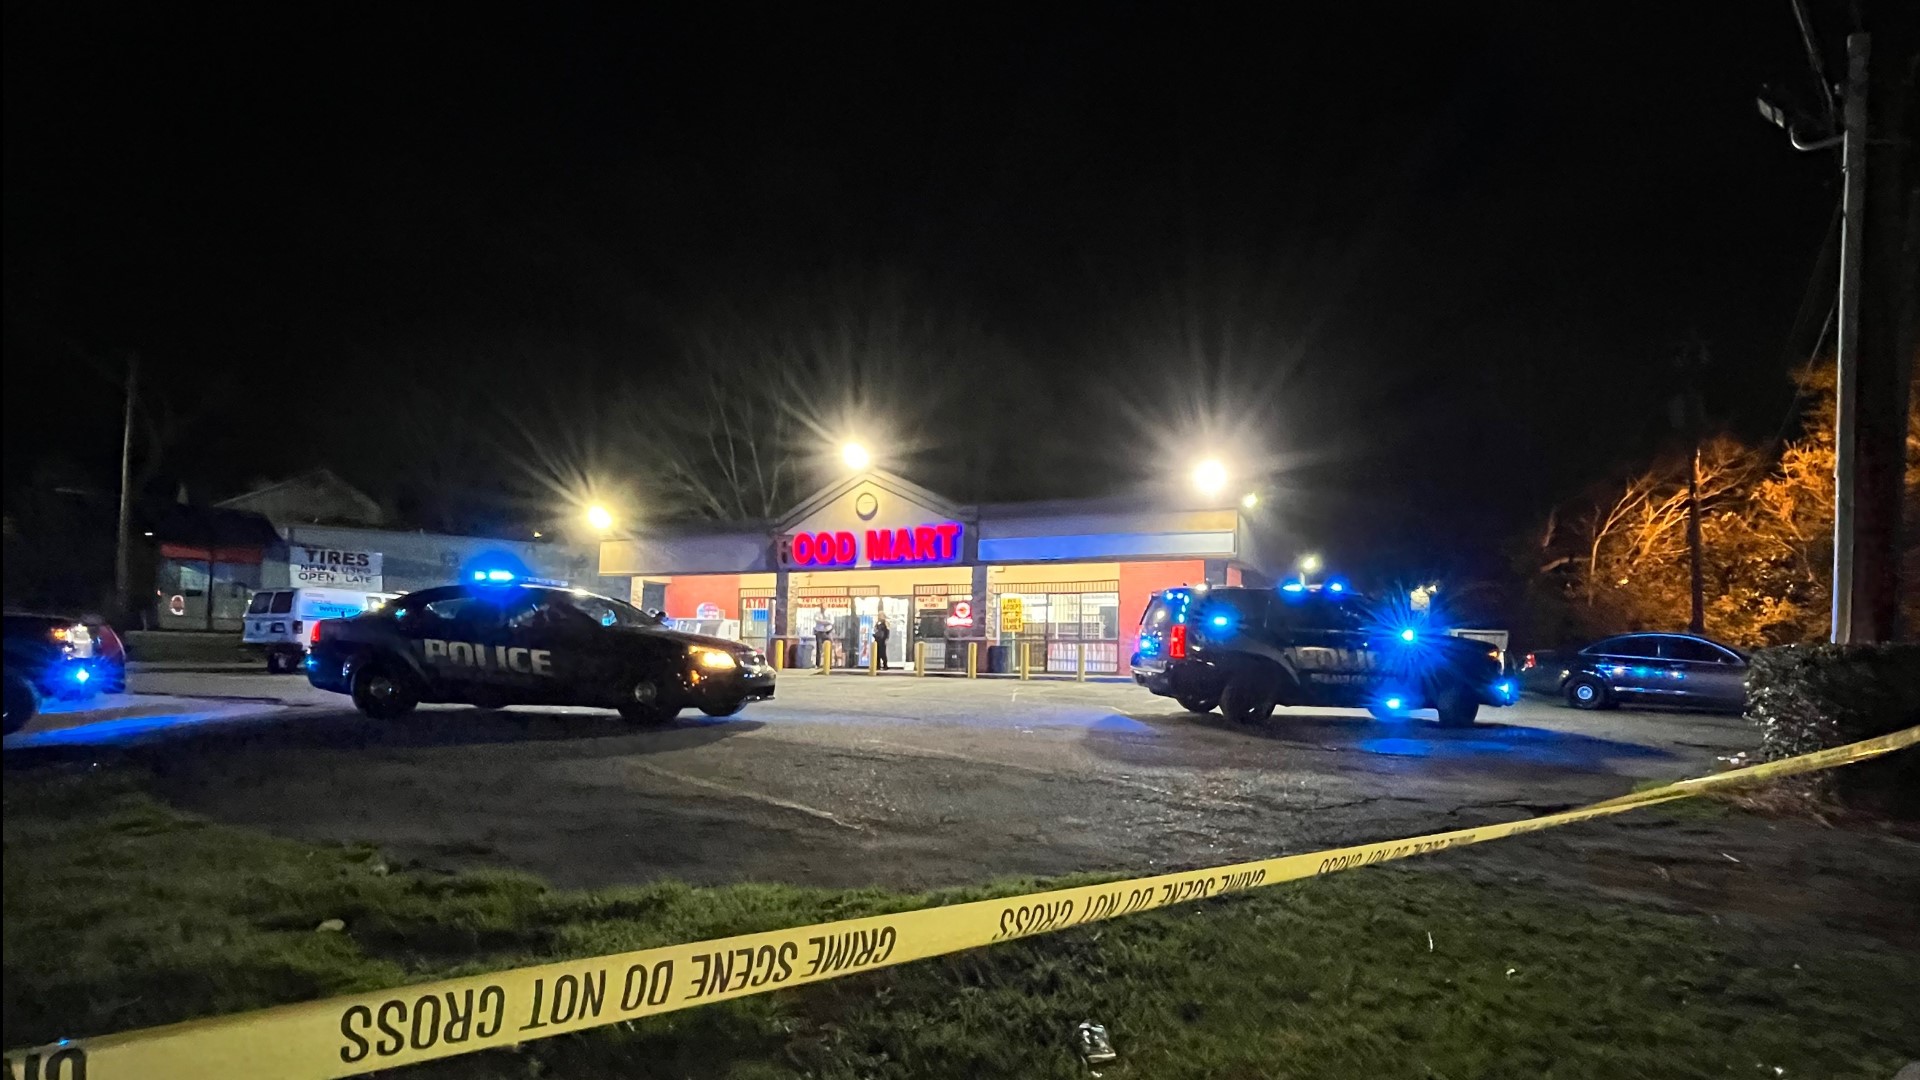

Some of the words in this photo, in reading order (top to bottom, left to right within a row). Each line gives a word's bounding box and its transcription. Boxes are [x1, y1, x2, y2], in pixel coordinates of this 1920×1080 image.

[305, 549, 369, 567] TIRES
[865, 523, 959, 561] MART
[299, 573, 334, 582] OPEN
[346, 574, 371, 583] LATE
[745, 597, 766, 608] ATM
[424, 638, 554, 677] POLICE
[992, 899, 1074, 941] CROSS
[684, 941, 798, 1000] SCENE
[799, 926, 897, 978] CRIME
[519, 969, 606, 1032] NOT
[620, 960, 673, 1012] DO
[340, 985, 505, 1063] CROSS
